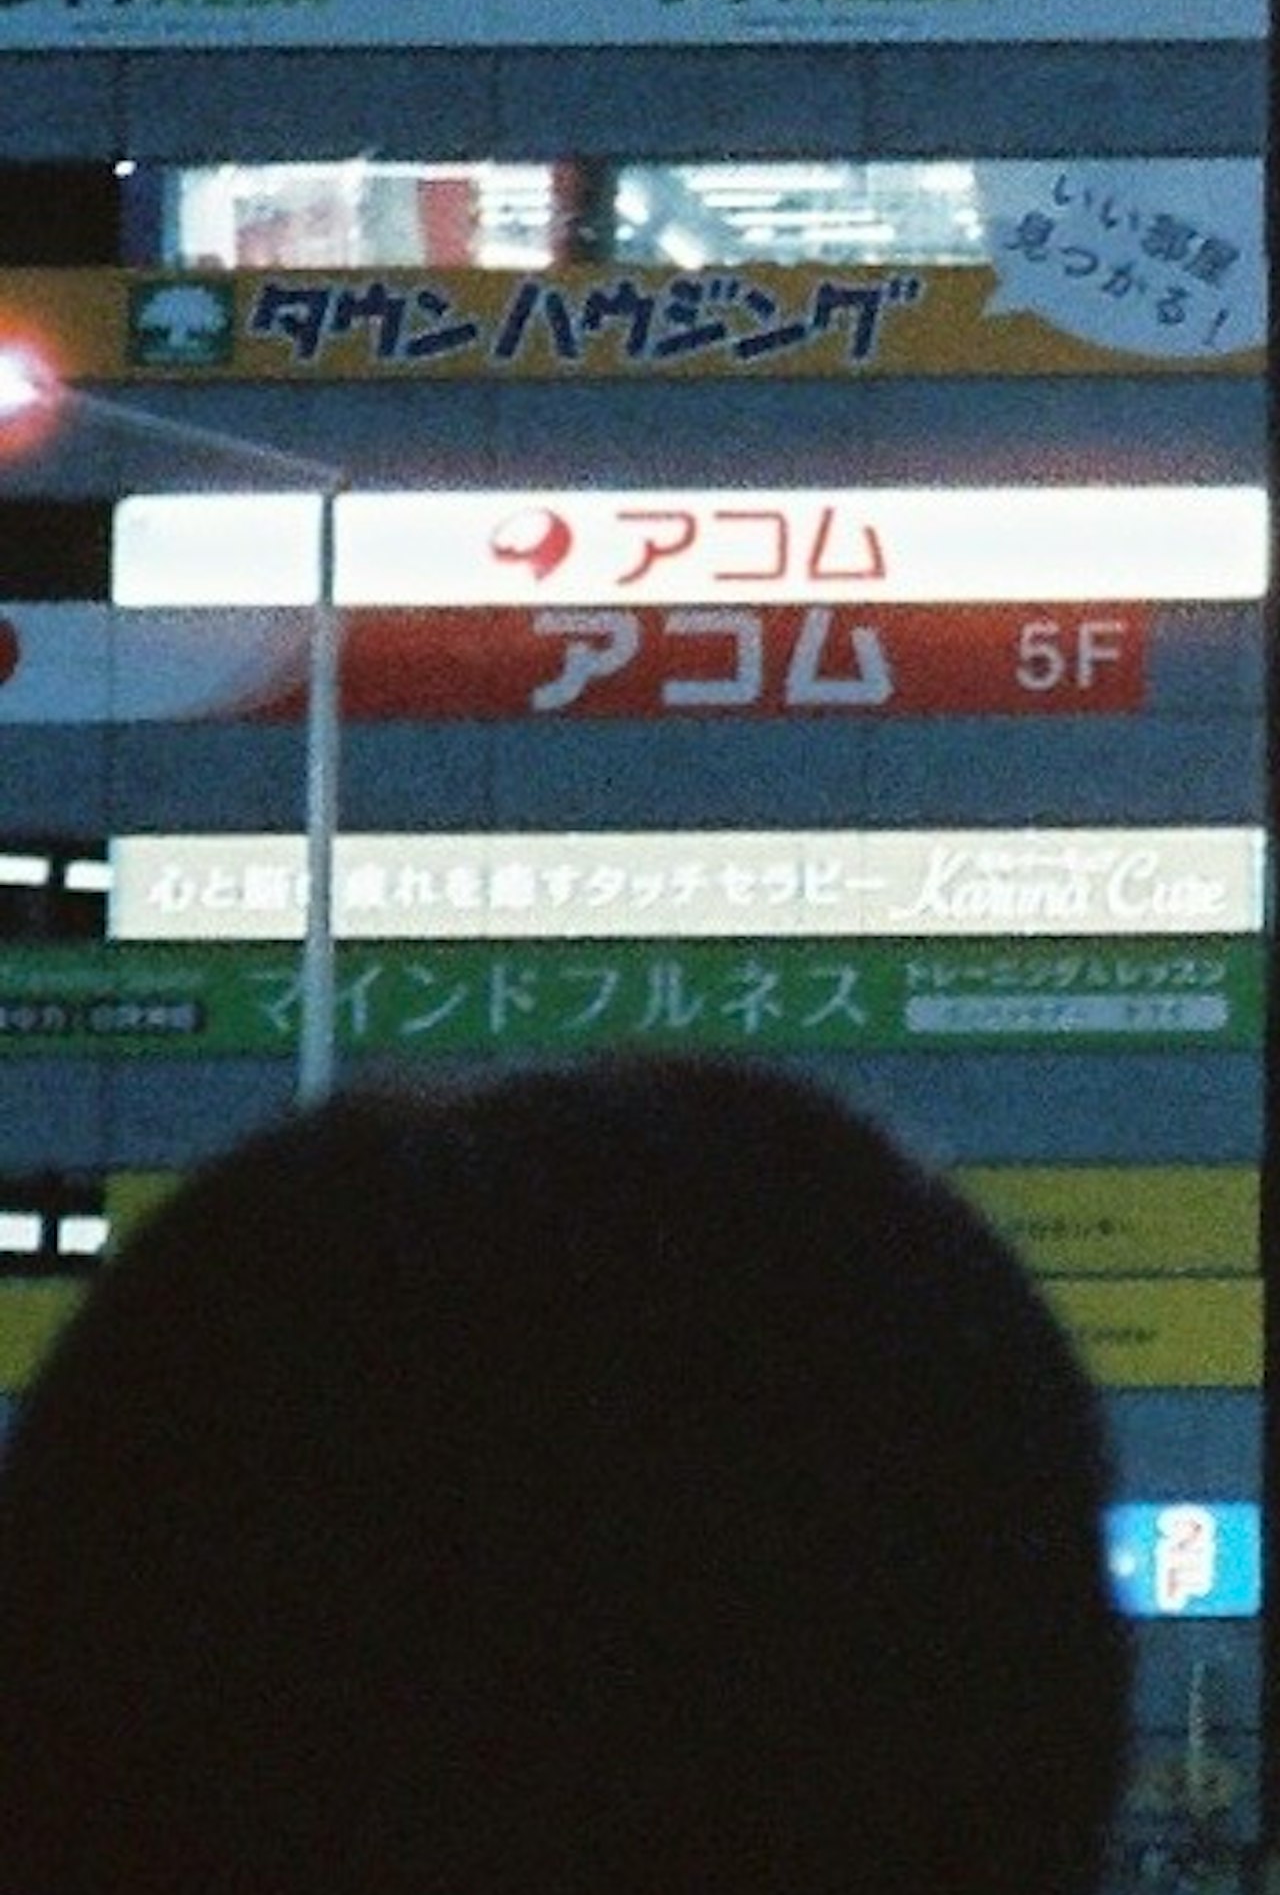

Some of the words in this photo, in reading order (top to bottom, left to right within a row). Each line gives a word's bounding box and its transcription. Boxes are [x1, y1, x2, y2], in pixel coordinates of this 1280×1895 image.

[247, 279, 922, 361] タウンハウジング
[616, 507, 888, 583] アコム
[531, 608, 896, 706] アコム
[1013, 621, 1126, 692] 5F
[242, 960, 873, 1035] マインドフルネス
